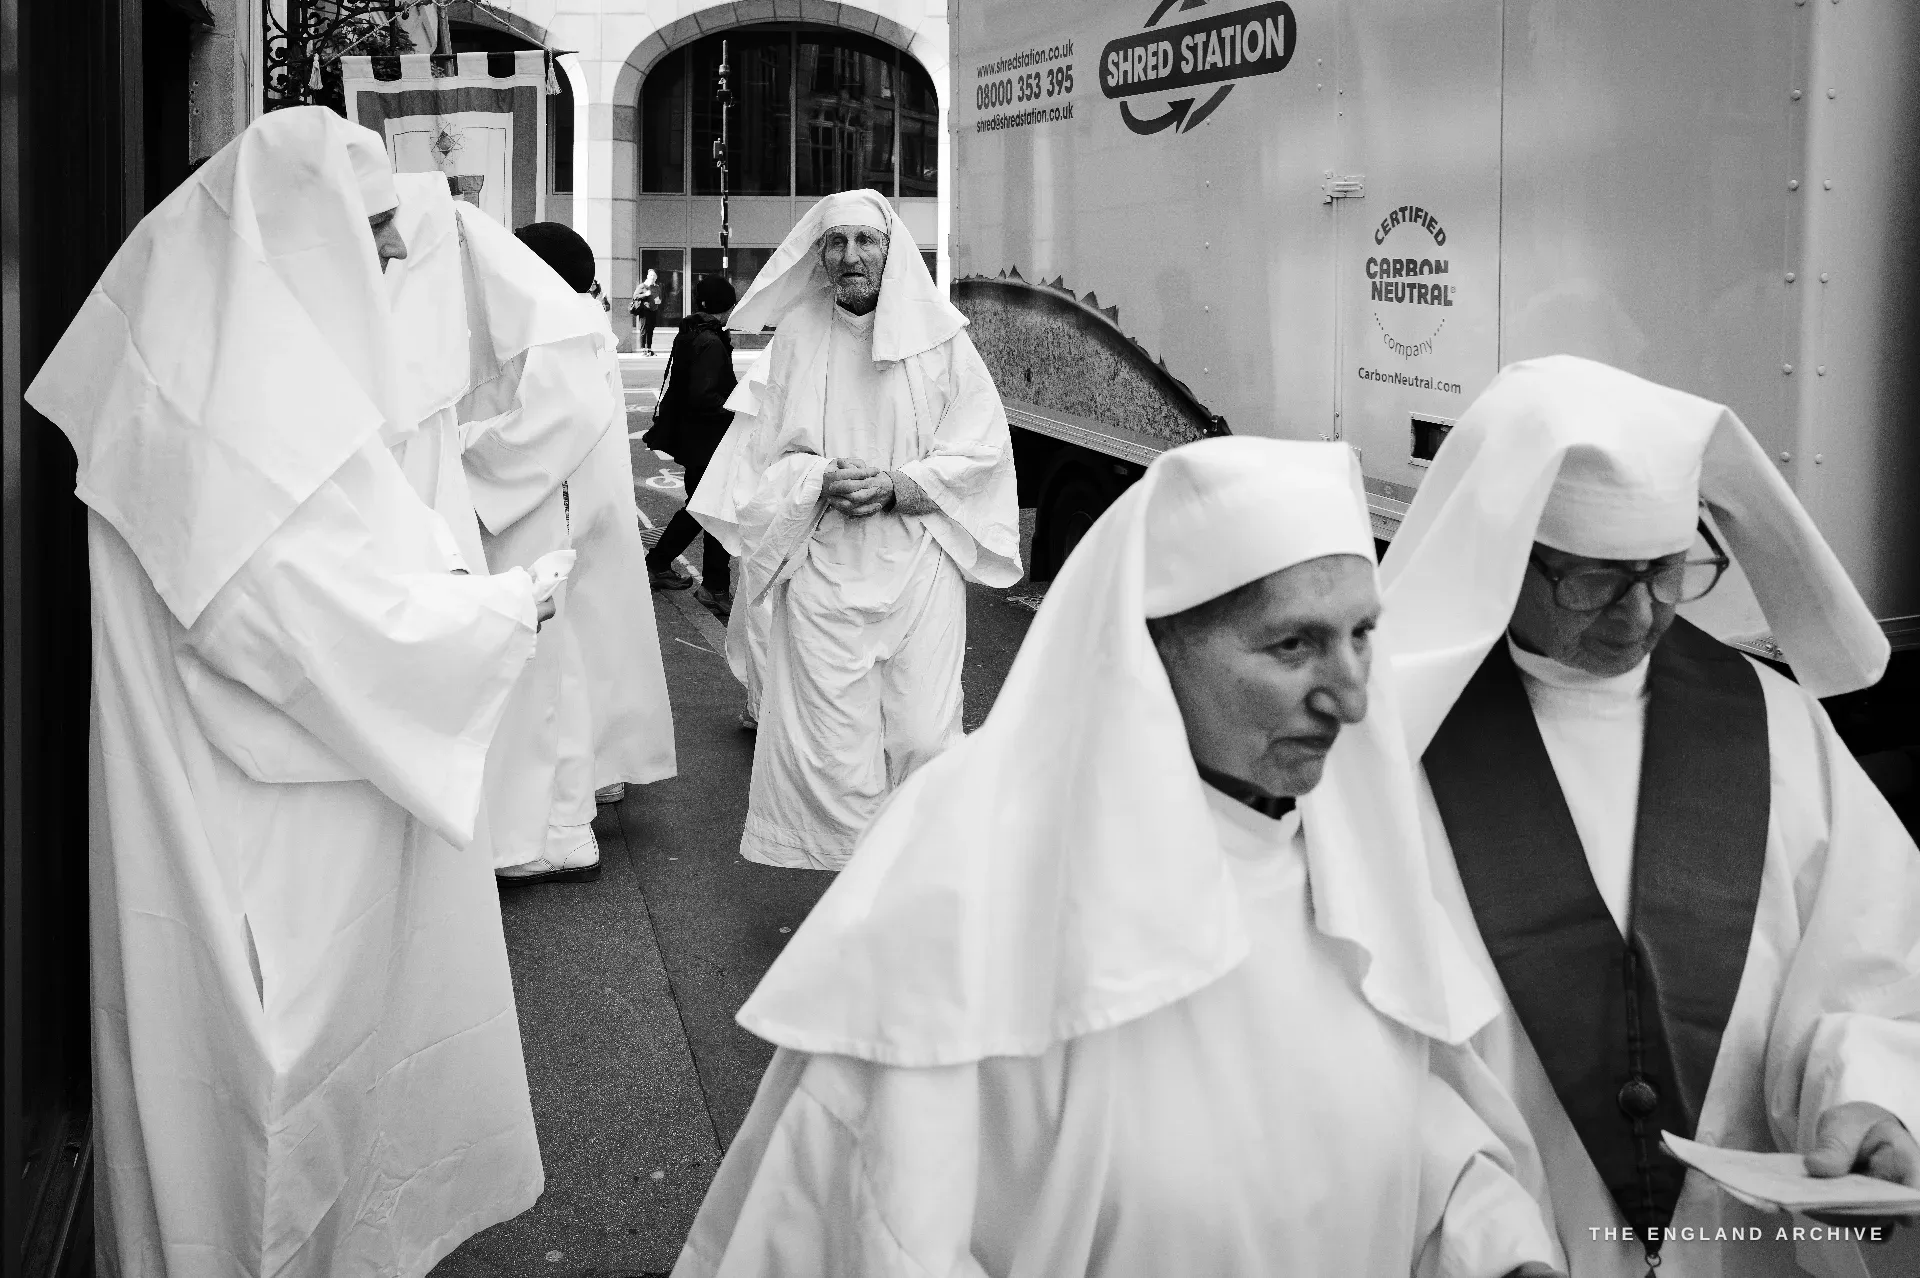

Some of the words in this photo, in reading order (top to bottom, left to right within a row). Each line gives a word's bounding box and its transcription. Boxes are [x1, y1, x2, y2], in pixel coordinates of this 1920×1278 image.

[976, 39, 1074, 79] www.shredstation.co.uk
[1106, 40, 1174, 88] SHRED
[1180, 15, 1286, 74] STATION
[976, 78, 1013, 111] 08000
[1017, 71, 1042, 103] 353
[1046, 64, 1074, 97] 395
[976, 102, 1074, 134] shred@shredstation.co.uk
[1374, 205, 1447, 247] CERTIFIED
[1365, 257, 1449, 280] CARBON
[1383, 333, 1433, 361] company
[1358, 366, 1462, 394] CarbonNeutral.com
